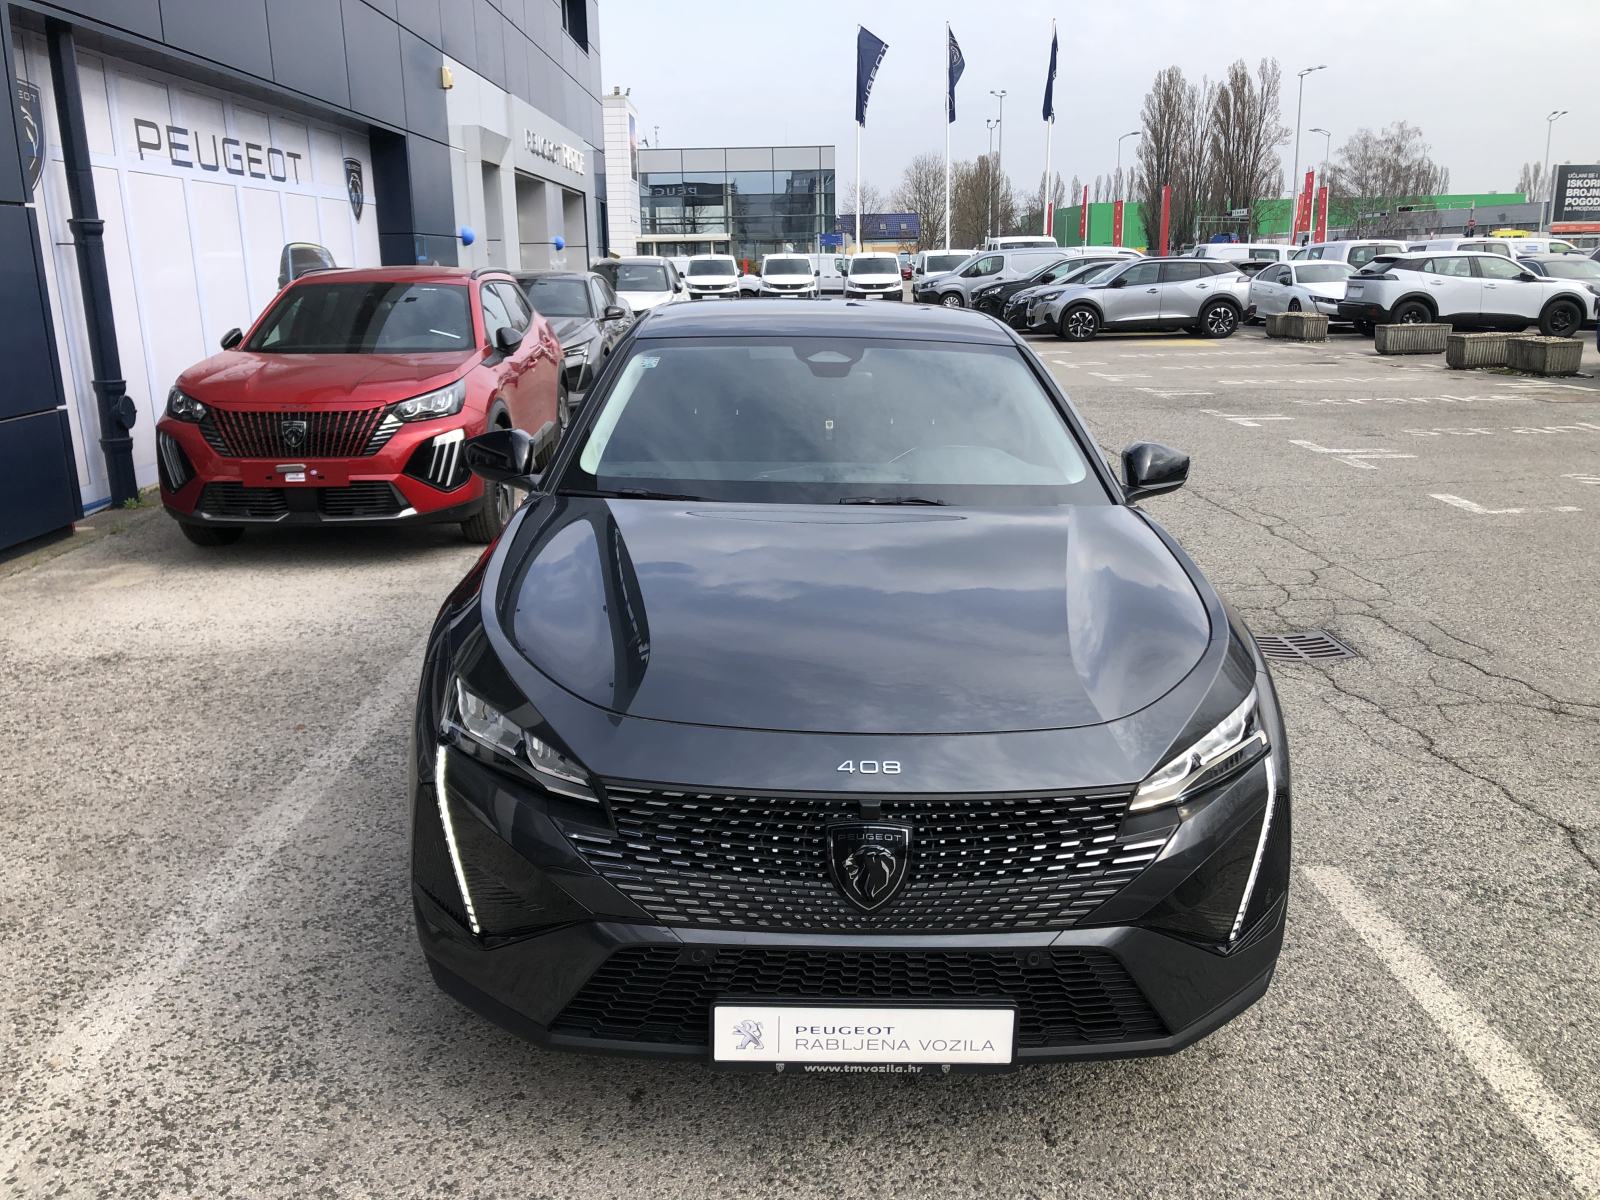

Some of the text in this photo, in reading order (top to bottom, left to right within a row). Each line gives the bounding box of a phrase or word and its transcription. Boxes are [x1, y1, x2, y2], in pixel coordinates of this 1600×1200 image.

[134, 117, 302, 185] PEUGEOT
[837, 760, 901, 774] 408
[837, 833, 902, 842] PEUGEOT
[795, 1025, 896, 1036] PEUGEOT
[794, 1038, 996, 1052] RABLJENA VOZILA
[803, 1064, 923, 1074] www.tmvozila.hr
